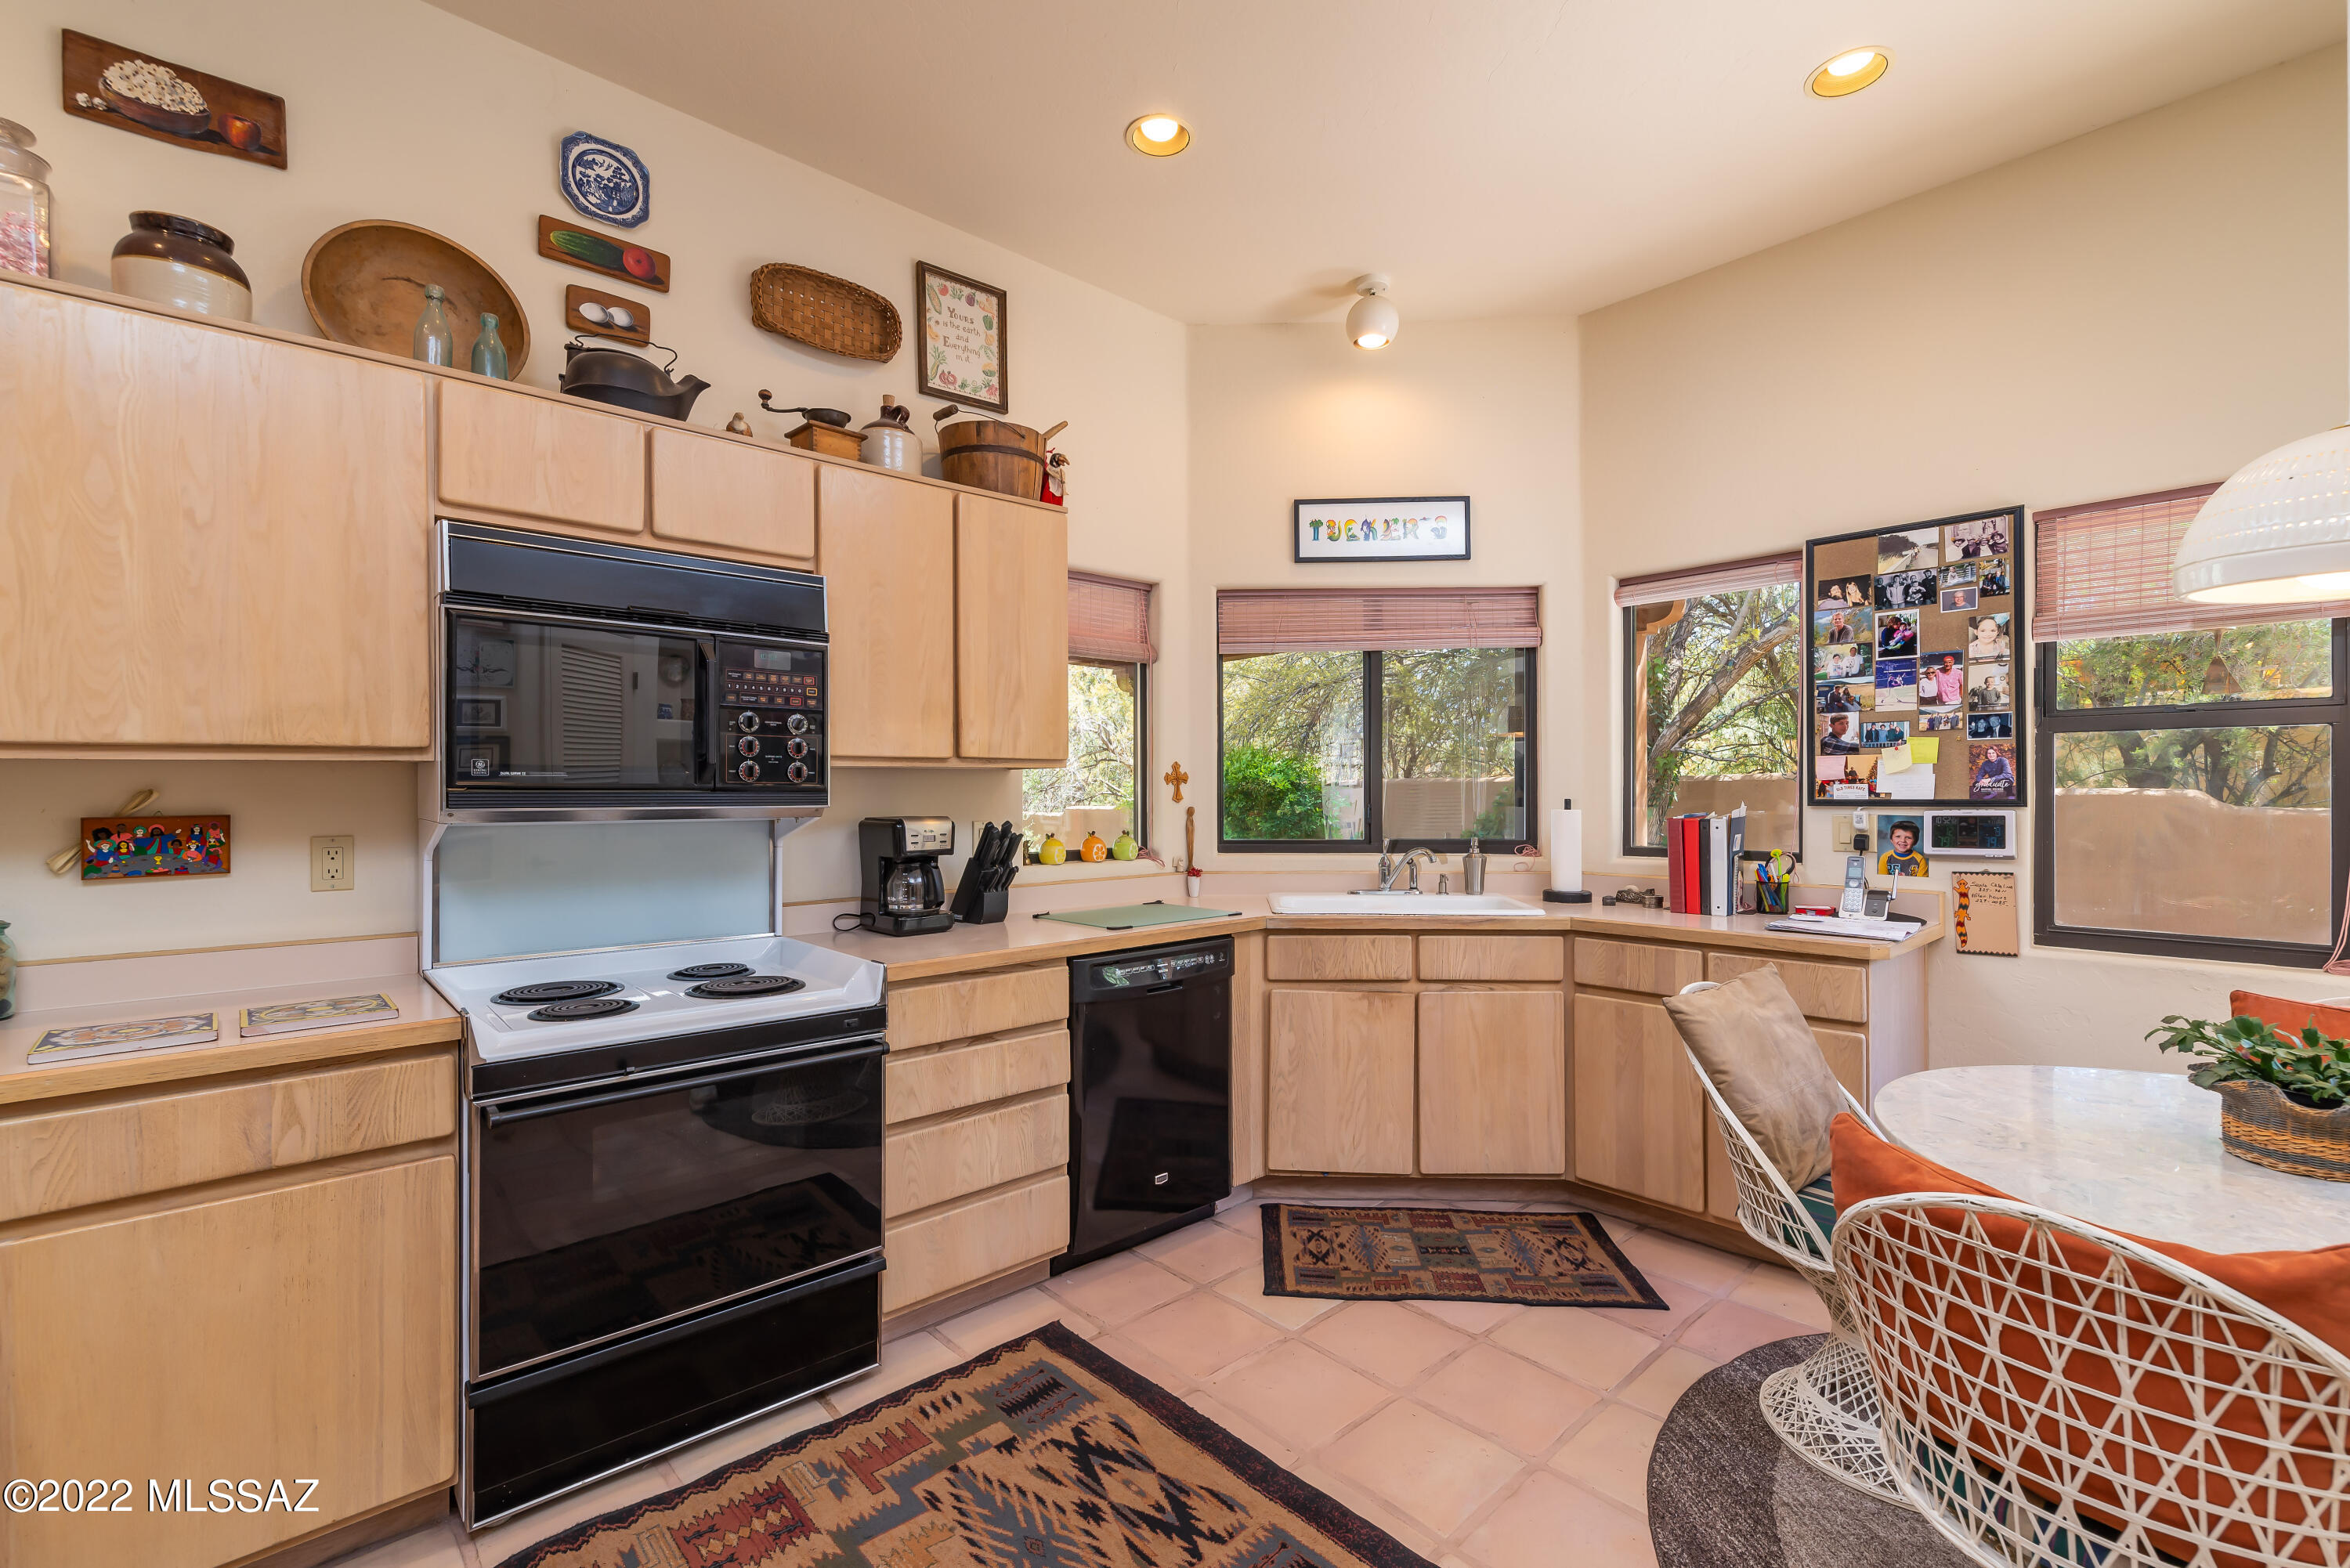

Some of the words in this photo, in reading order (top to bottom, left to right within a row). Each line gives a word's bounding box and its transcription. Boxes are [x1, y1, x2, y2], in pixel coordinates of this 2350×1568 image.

[949, 320, 960, 331] the
[962, 327, 981, 338] earth
[942, 335, 981, 359] Everything
[956, 334, 969, 343] and
[1309, 514, 1448, 542] TUCKER'S
[1973, 777, 2011, 793] graduate
